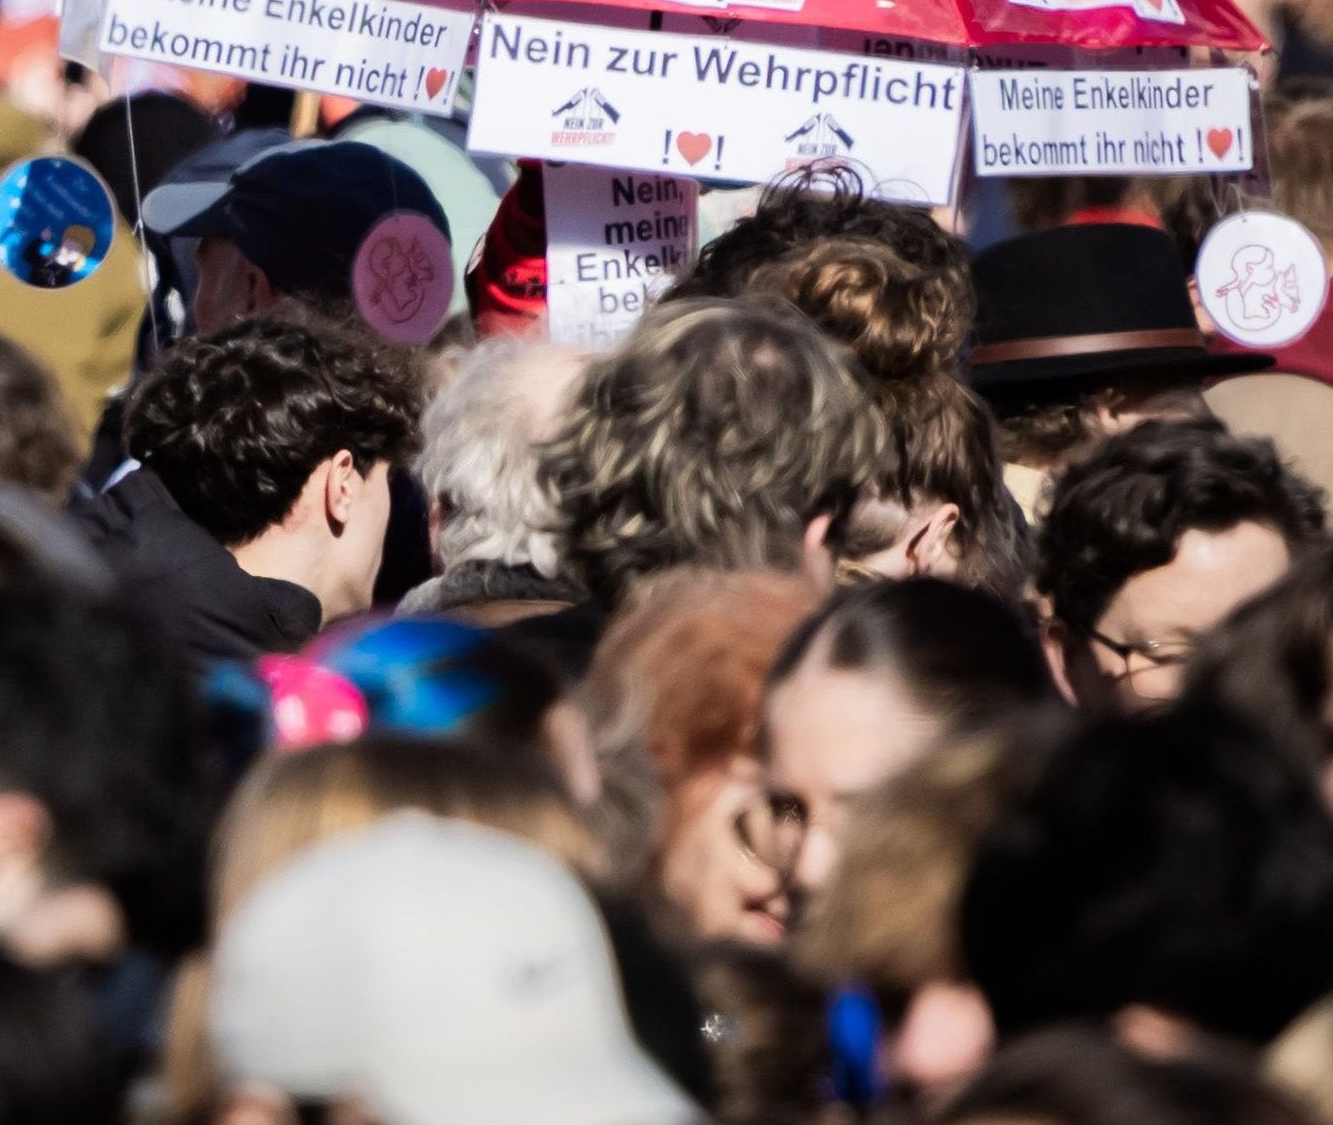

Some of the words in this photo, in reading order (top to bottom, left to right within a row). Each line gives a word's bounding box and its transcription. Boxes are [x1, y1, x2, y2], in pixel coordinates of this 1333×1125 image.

[107, 14, 272, 73] bekommt
[280, 44, 326, 81] ihr
[334, 53, 408, 96] nicht
[490, 24, 591, 69] Nein
[606, 46, 679, 79] zur
[694, 46, 957, 111] Wehrpflicht
[1000, 78, 1064, 111] Meine
[1073, 78, 1215, 110] Enkelkinder
[983, 133, 1087, 167] bekommt
[1096, 131, 1126, 165] ihr
[1134, 129, 1184, 165] nicht
[611, 176, 683, 208] Nein,
